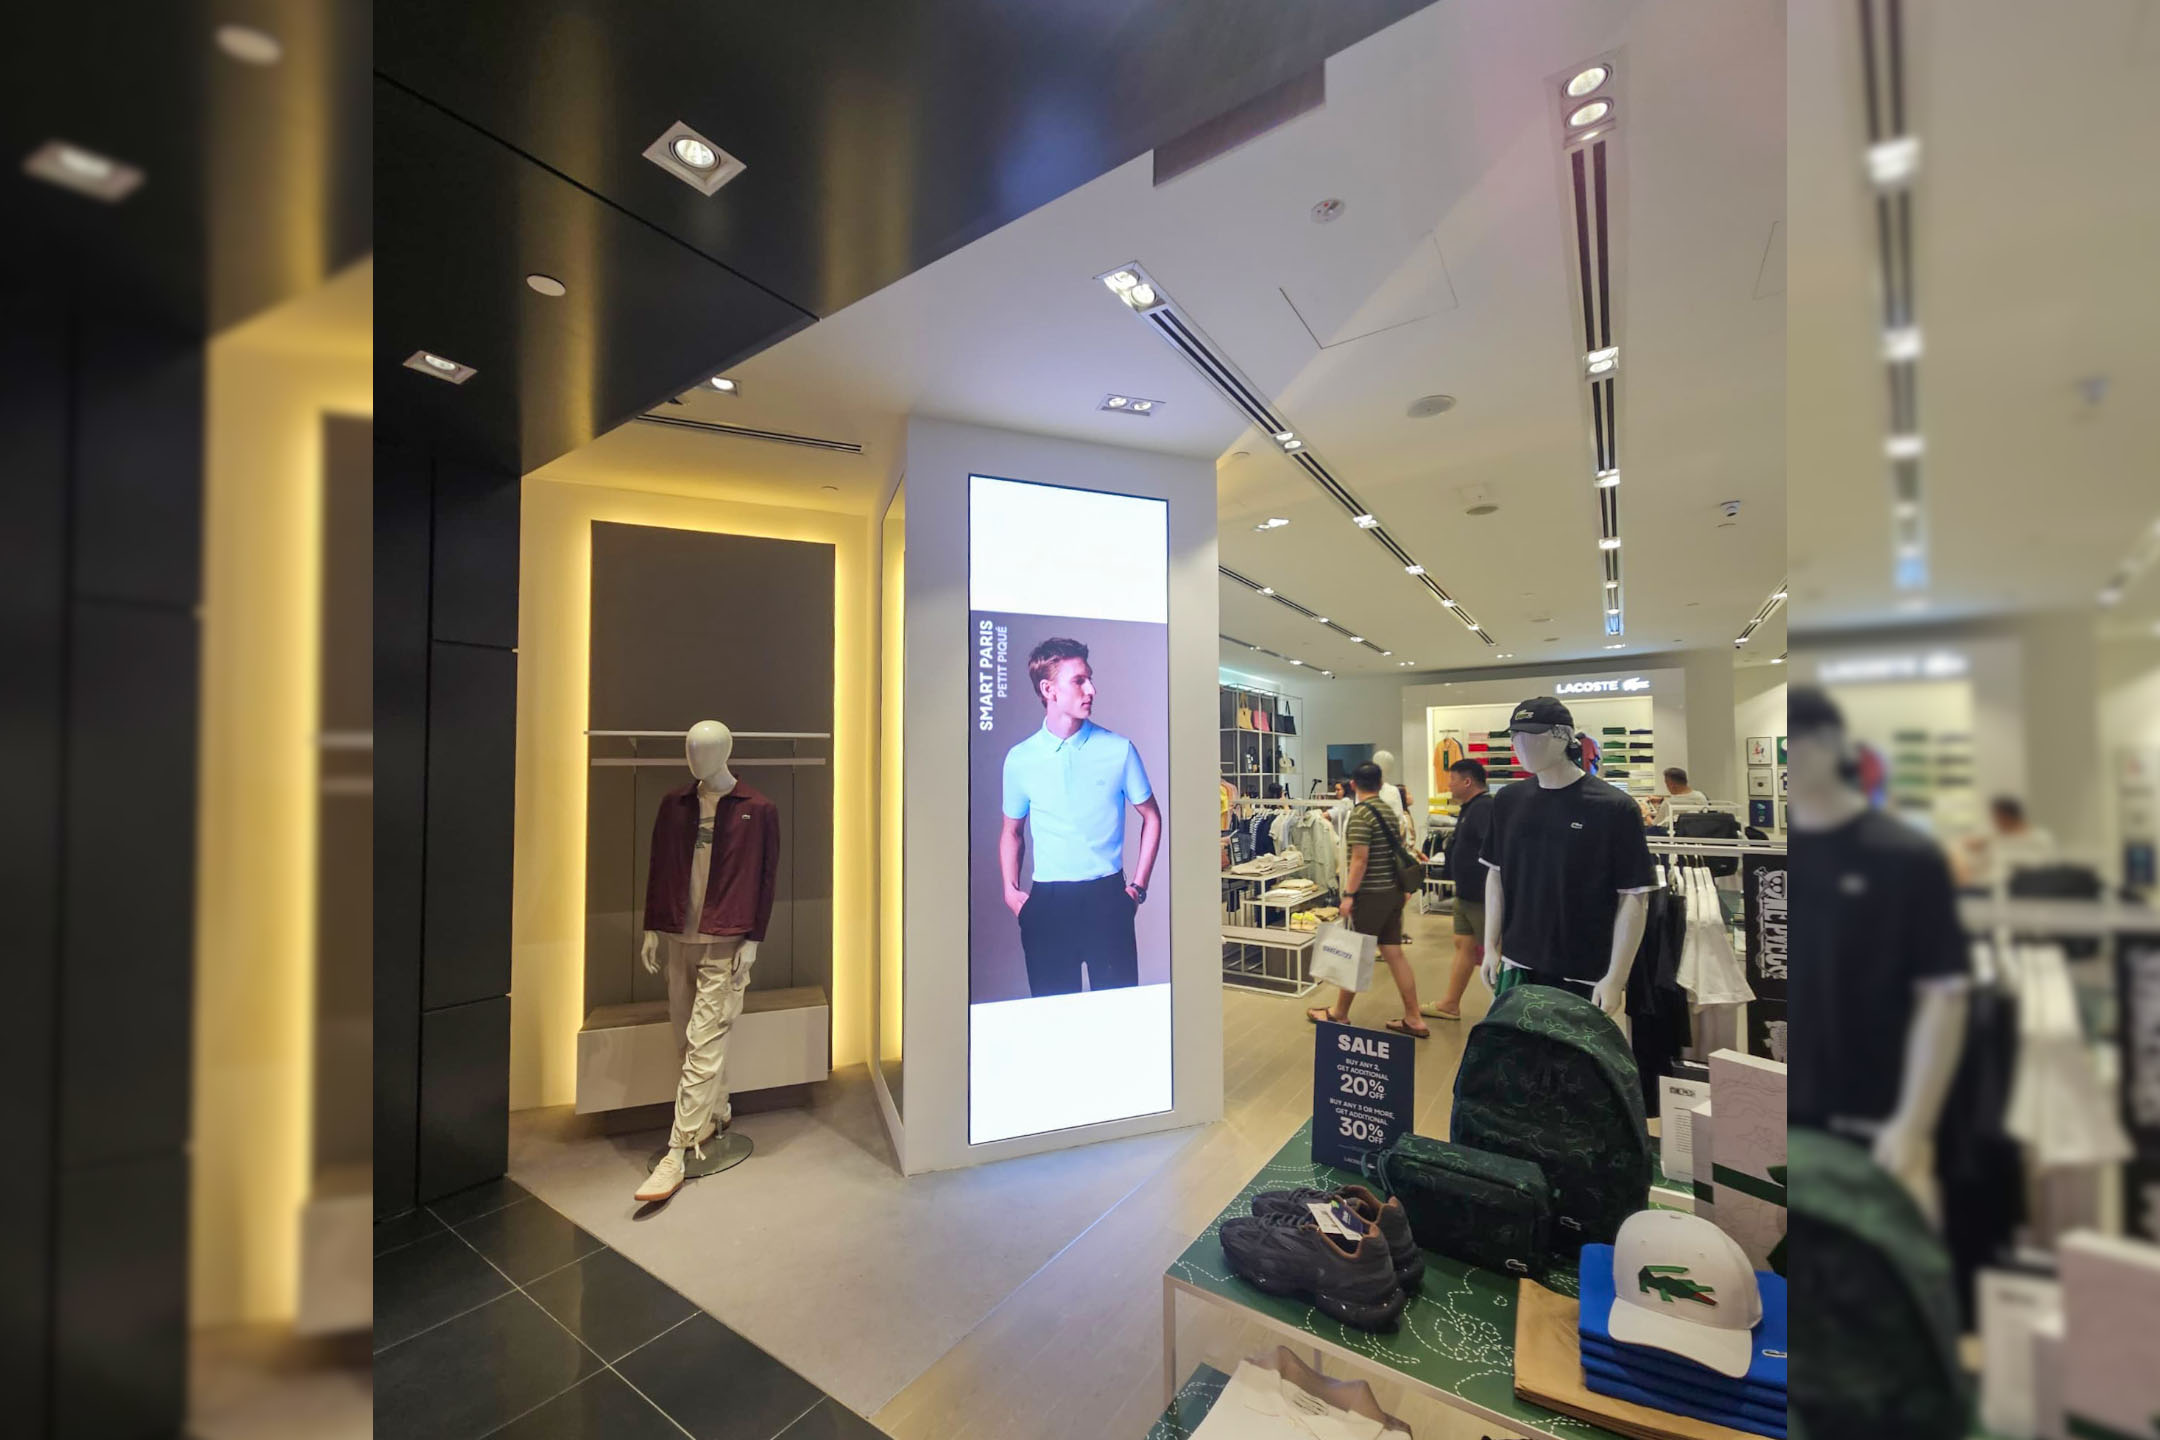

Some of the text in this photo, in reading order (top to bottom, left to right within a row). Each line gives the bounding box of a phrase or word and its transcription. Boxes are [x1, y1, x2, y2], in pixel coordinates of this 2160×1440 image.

[996, 626, 1007, 698] PETIT PIQUÉ
[980, 620, 993, 731] SMART PARIS
[1556, 680, 1619, 694] LACOSTE
[1338, 1034, 1390, 1059] SALE
[1337, 1064, 1389, 1081] GET ADDITIONAL
[1346, 1058, 1358, 1066] BUY
[1359, 1061, 1373, 1069] ANY
[1340, 1073, 1384, 1096] 20%
[1330, 1097, 1342, 1105] BUY
[1343, 1101, 1357, 1109] ANY
[1363, 1105, 1373, 1113] OR
[1335, 1107, 1388, 1125] GET ADDITIONAL
[1339, 1116, 1384, 1140] 30%
